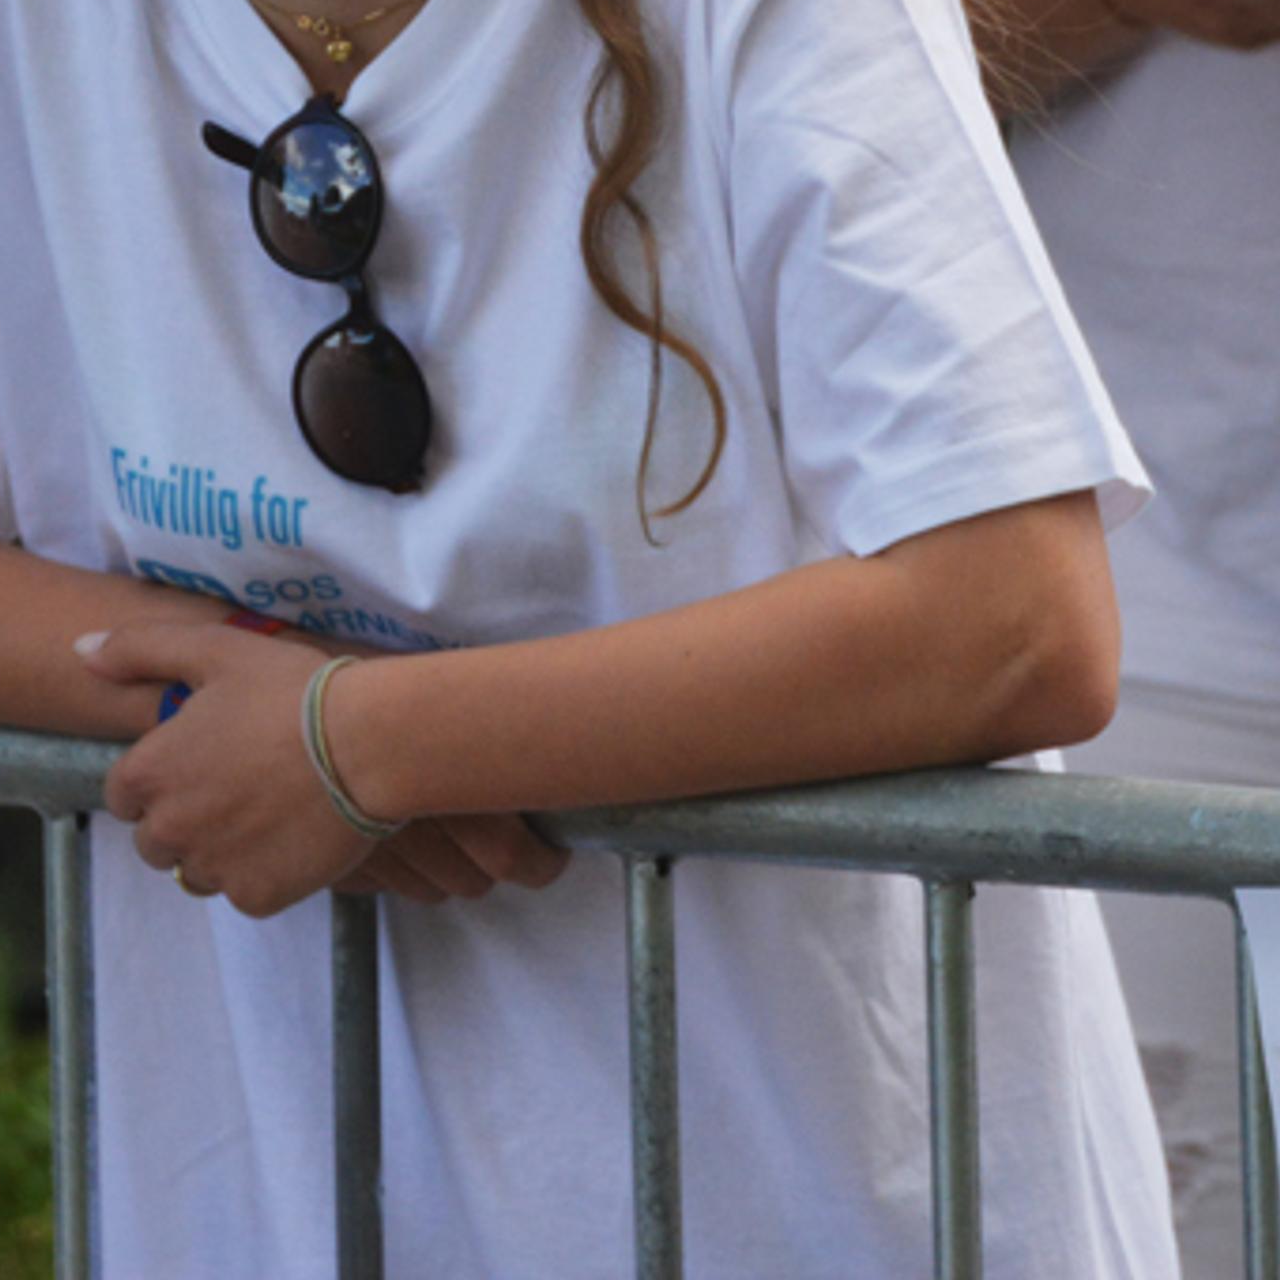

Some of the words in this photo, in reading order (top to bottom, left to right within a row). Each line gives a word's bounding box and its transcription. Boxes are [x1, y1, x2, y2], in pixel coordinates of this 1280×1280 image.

[111, 447, 242, 550] Frivillig
[250, 476, 308, 547] for
[244, 575, 342, 610] SOS
